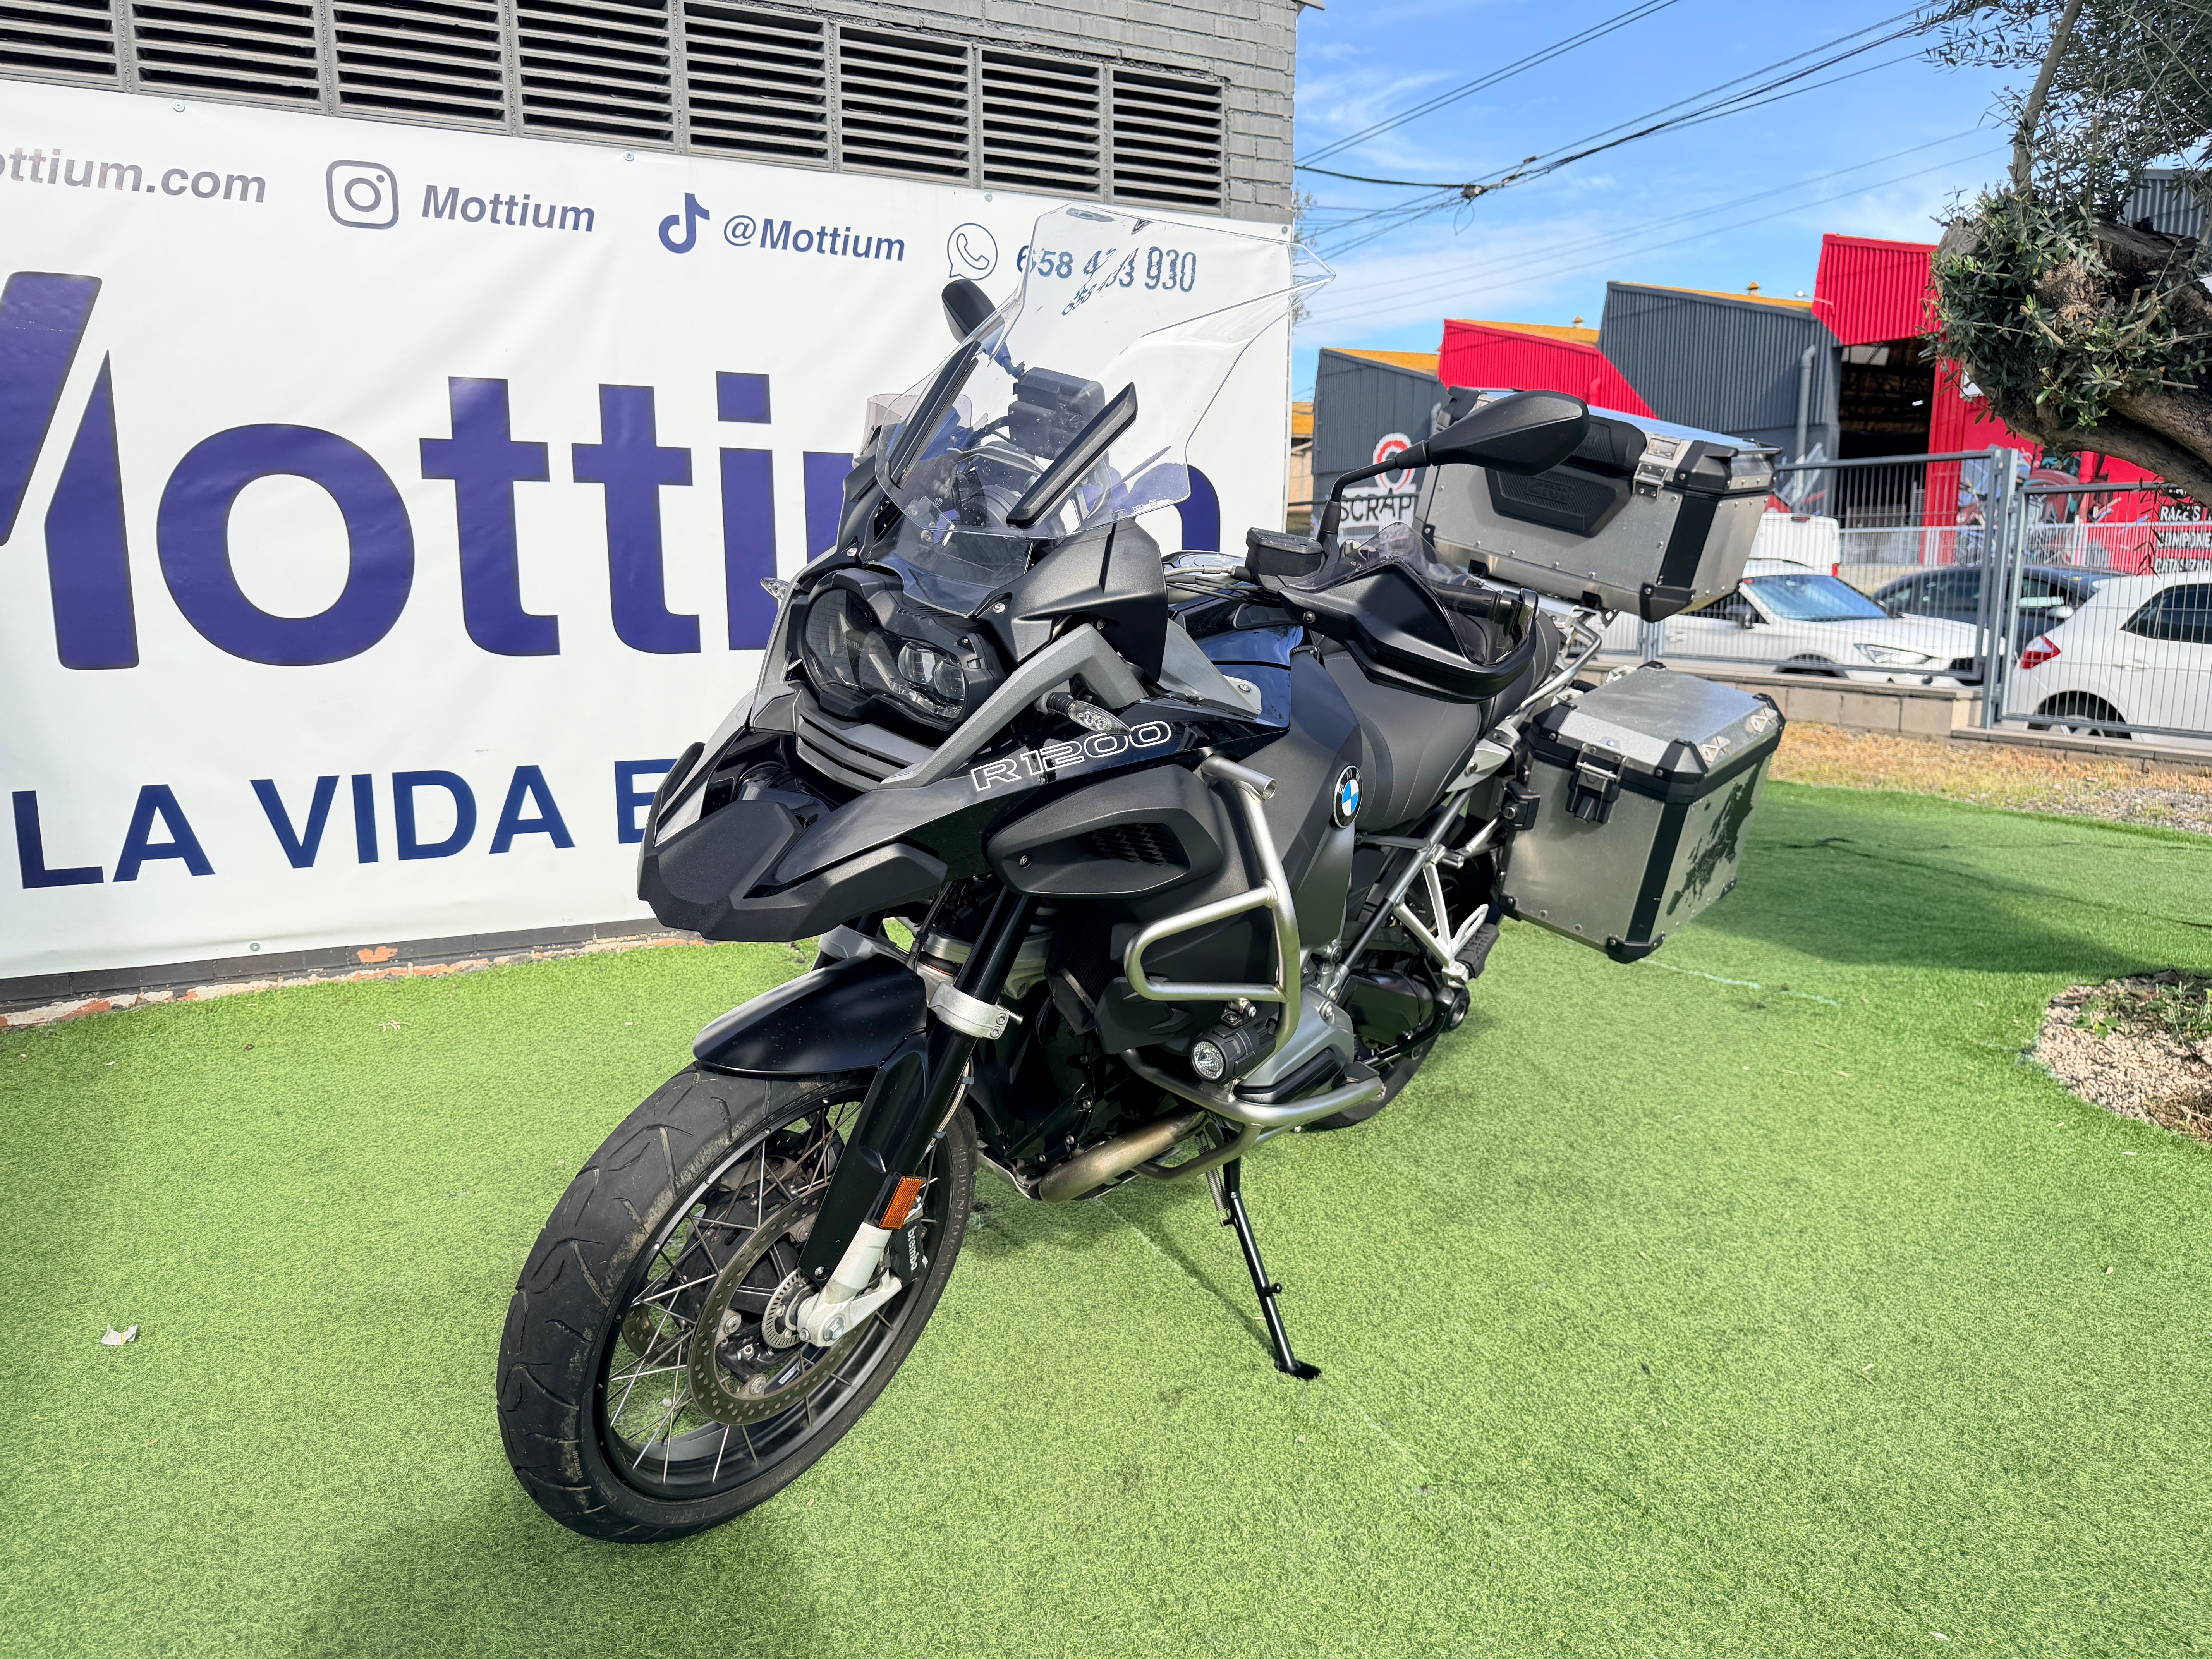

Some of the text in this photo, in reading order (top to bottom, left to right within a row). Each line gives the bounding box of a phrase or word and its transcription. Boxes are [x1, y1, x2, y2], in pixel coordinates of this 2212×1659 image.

[0, 147, 266, 203] ttium.com
[422, 184, 595, 232] Mottium
[723, 215, 905, 261] @Mottium
[1016, 244, 1074, 279] 658
[1340, 487, 1412, 522] SCRAP
[970, 720, 1172, 792] R1200
[1337, 768, 1361, 795] BMW
[11, 783, 216, 890] LA
[249, 764, 576, 869] VIDA
[907, 1225, 919, 1271] brembo
